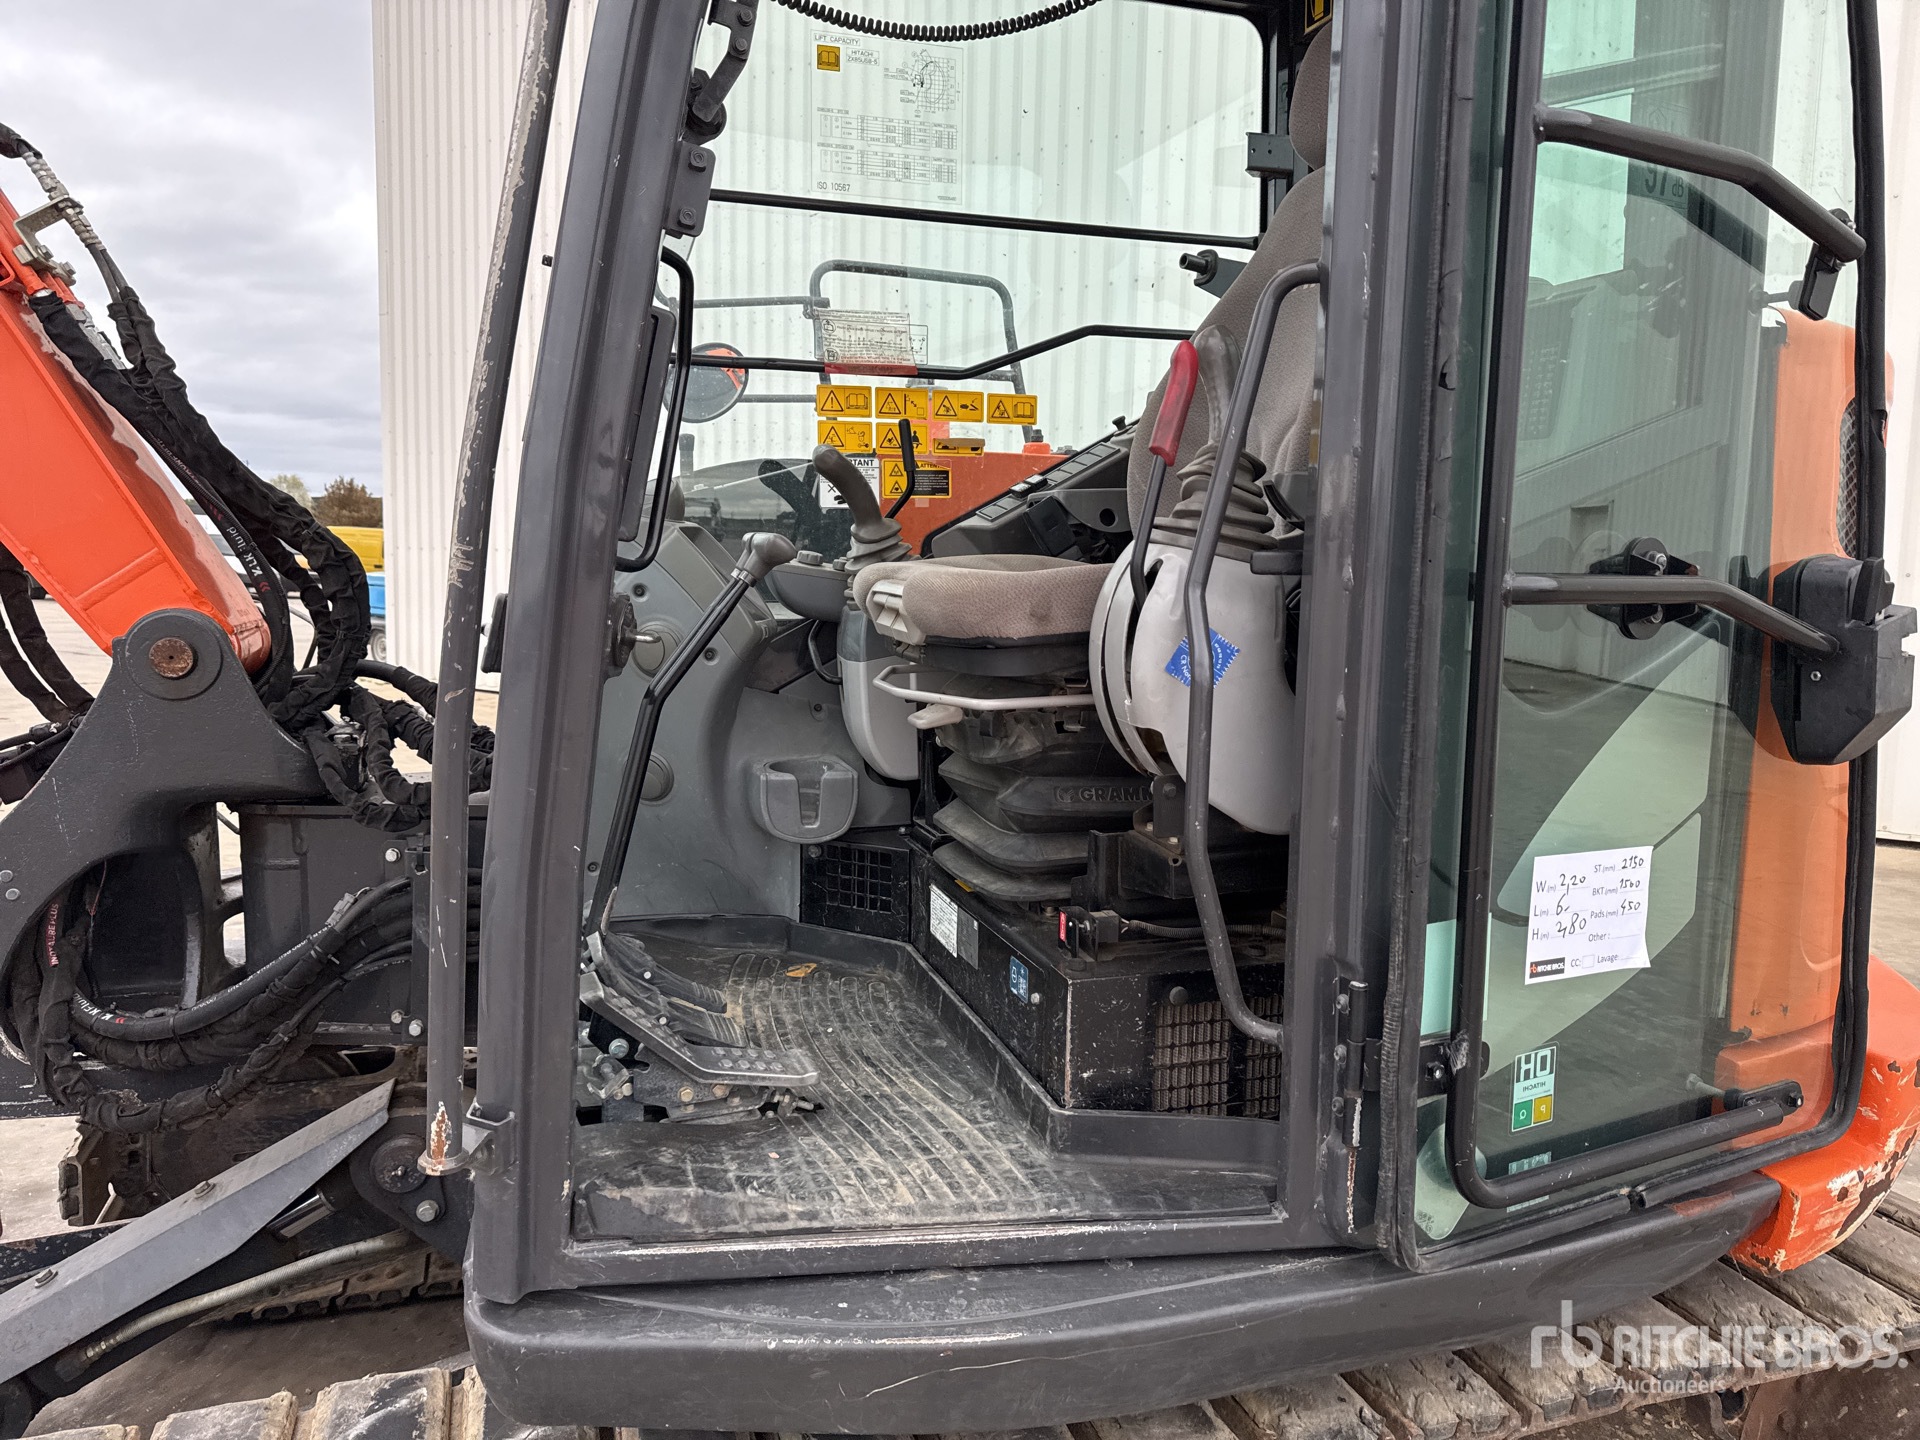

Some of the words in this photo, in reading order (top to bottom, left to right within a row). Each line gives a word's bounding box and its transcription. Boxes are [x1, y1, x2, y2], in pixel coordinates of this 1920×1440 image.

[829, 36, 859, 45] CAPACITY
[817, 181, 827, 190] ISO
[831, 182, 851, 192] 10567
[1620, 898, 1641, 916] 450
